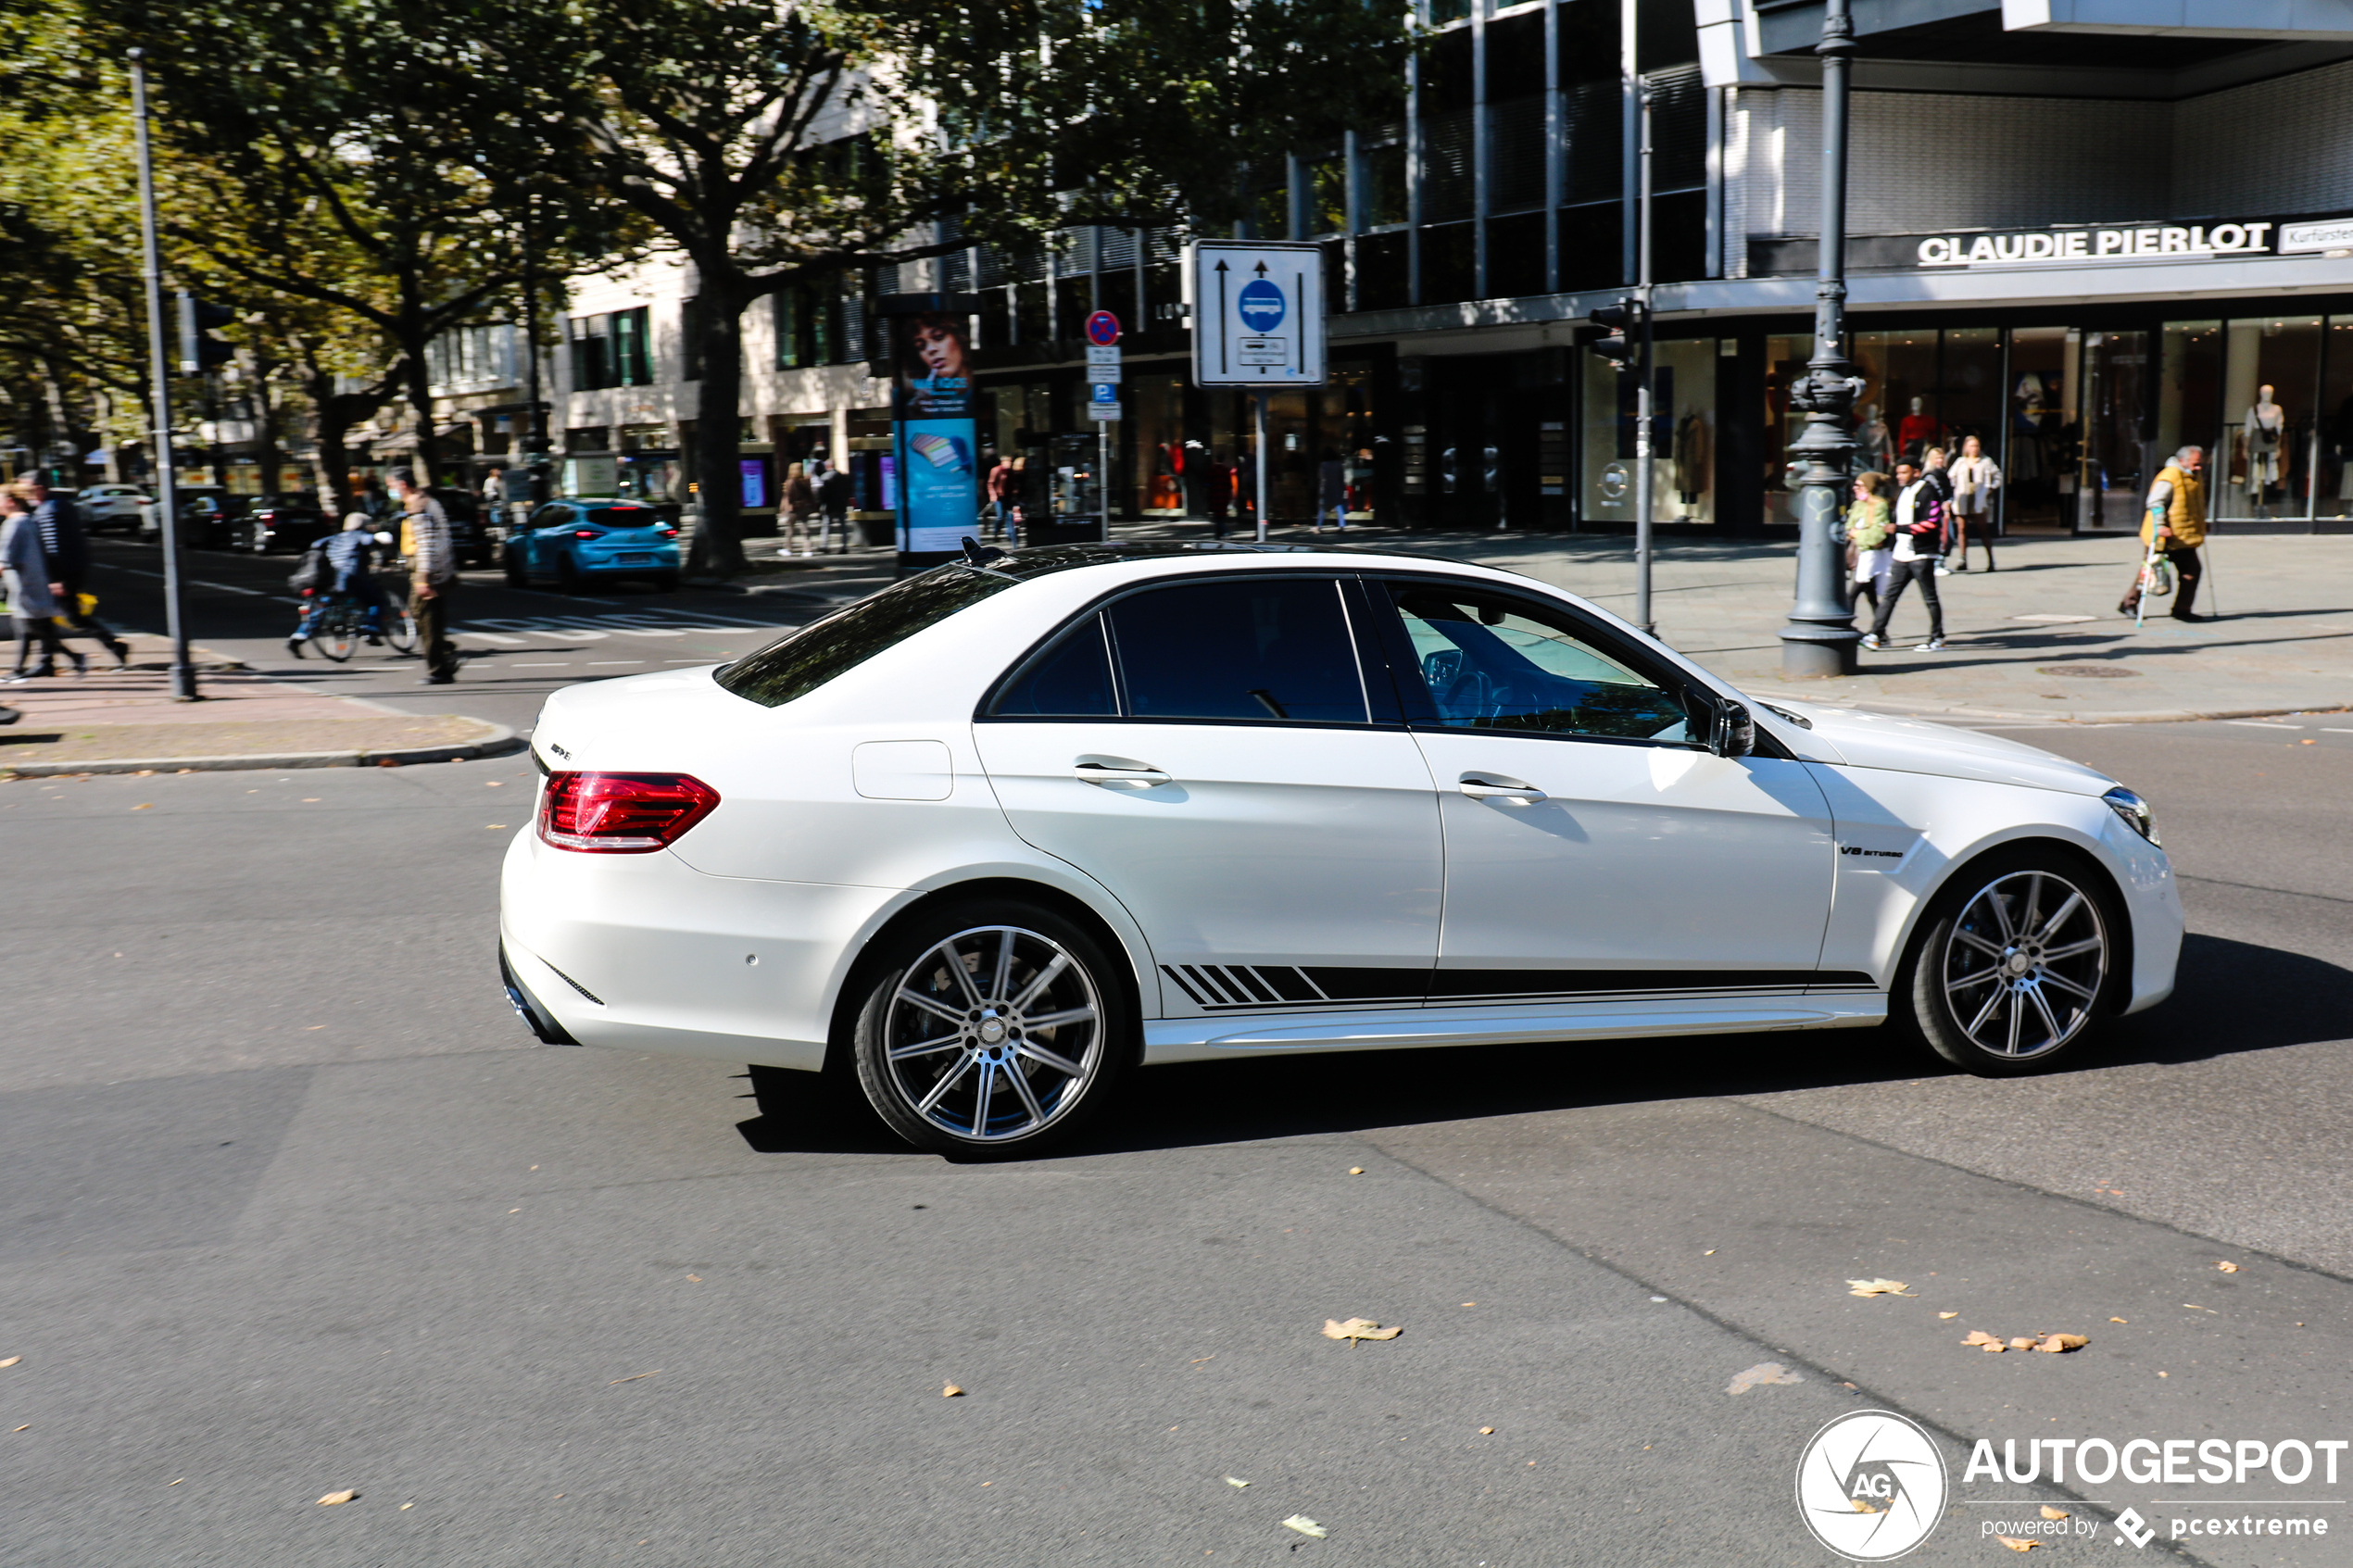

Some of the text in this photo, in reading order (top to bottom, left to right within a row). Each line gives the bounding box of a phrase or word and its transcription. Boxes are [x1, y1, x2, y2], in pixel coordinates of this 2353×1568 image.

[1918, 222, 2271, 263] CLAUDIE PIERLOT
[2288, 227, 2353, 243] Kurfürste
[1840, 847, 1862, 855] V8
